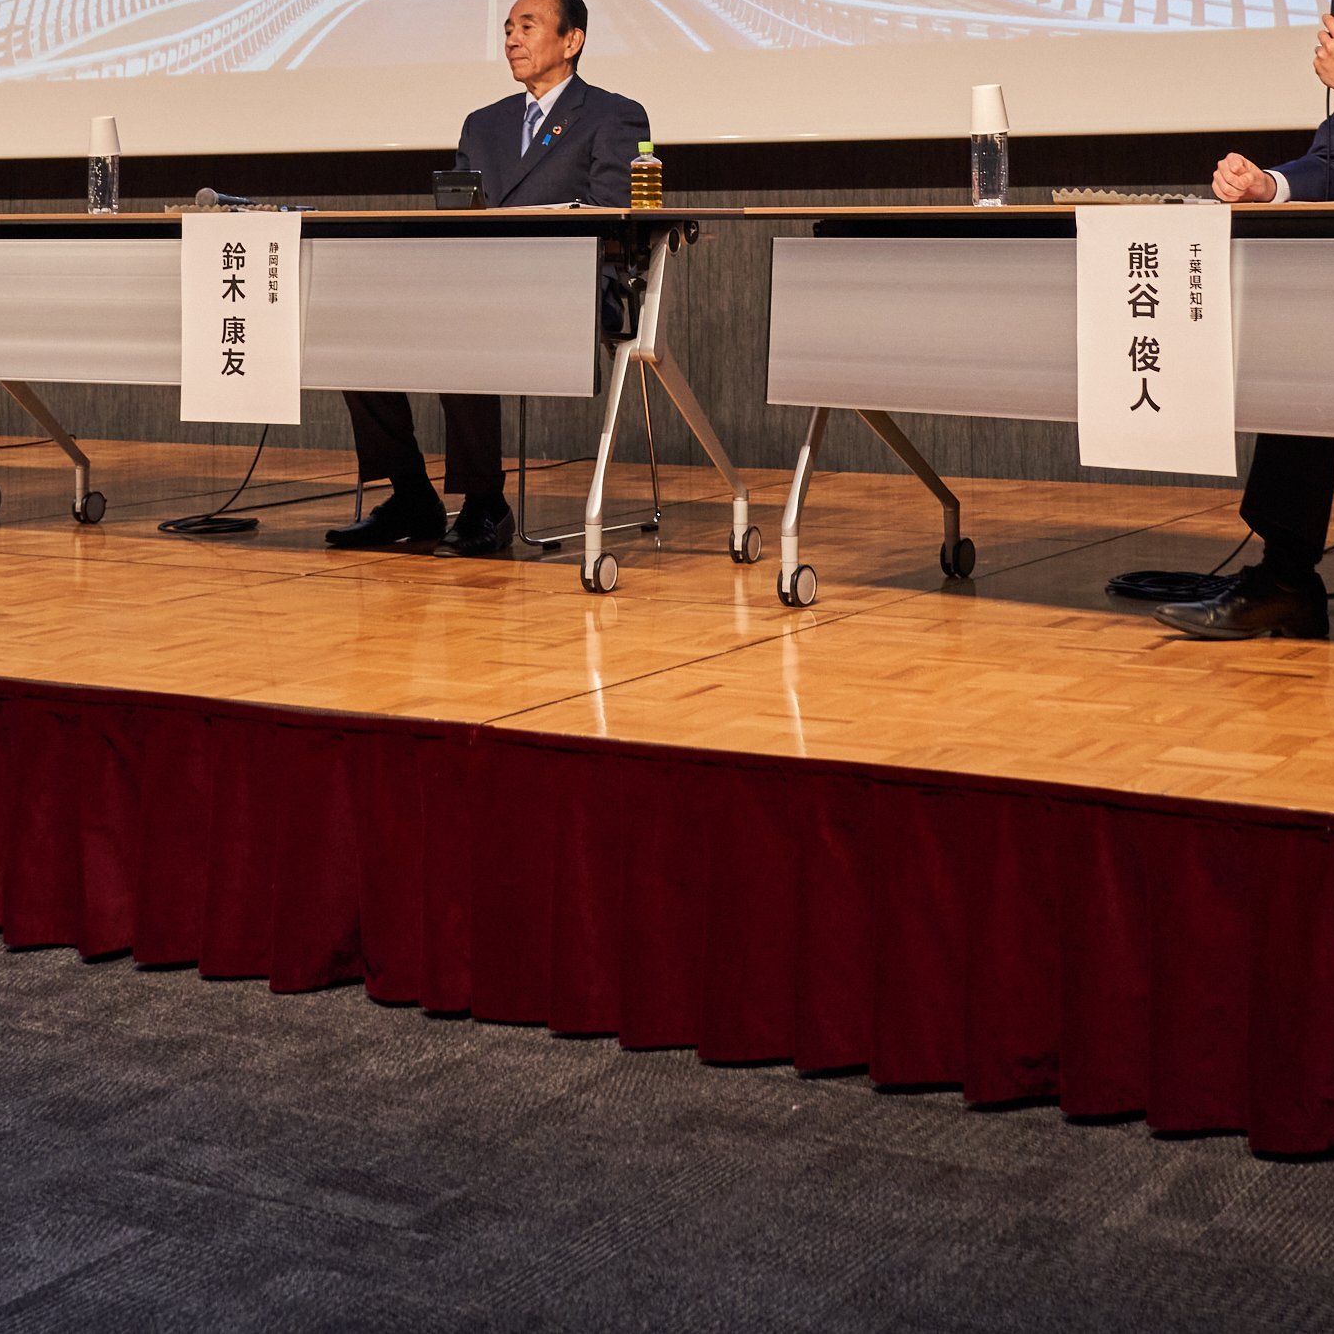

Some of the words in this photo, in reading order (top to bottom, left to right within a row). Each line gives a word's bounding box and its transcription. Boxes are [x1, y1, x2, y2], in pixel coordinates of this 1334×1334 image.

[222, 242, 246, 303] 鈴木
[268, 242, 279, 304] 静岡県知事
[1127, 242, 1160, 319] 熊谷
[1189, 243, 1203, 322] 千葉県知事
[221, 316, 246, 376] 康友
[1128, 335, 1161, 413] 俊人
